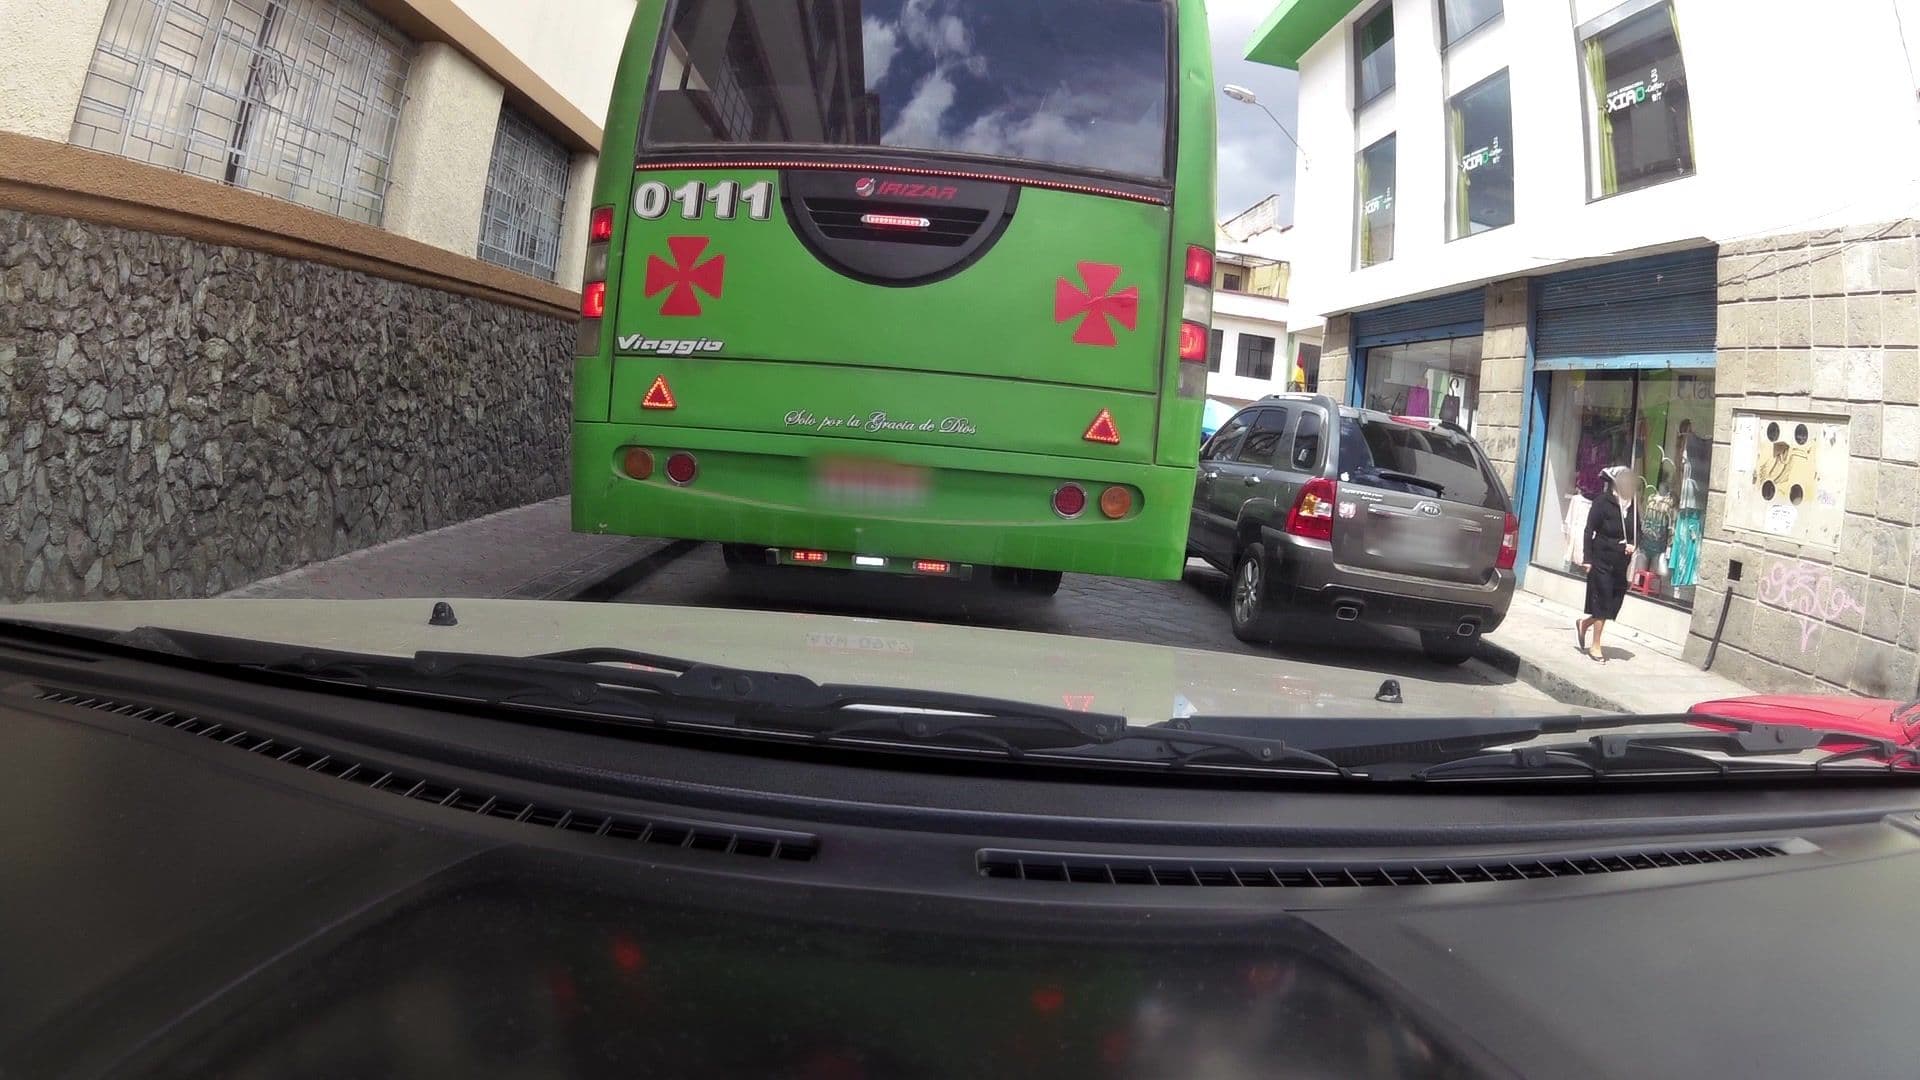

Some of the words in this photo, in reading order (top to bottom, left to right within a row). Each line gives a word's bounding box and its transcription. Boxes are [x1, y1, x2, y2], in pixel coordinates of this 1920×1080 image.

[633, 180, 775, 221] 0111
[878, 181, 958, 200] IRIZAR
[617, 333, 726, 356] Viaggio
[783, 409, 817, 427] Solo
[816, 415, 844, 432] por
[846, 414, 861, 428] la
[864, 411, 916, 433] Gracia
[918, 418, 935, 432] de
[938, 416, 977, 436] Dios
